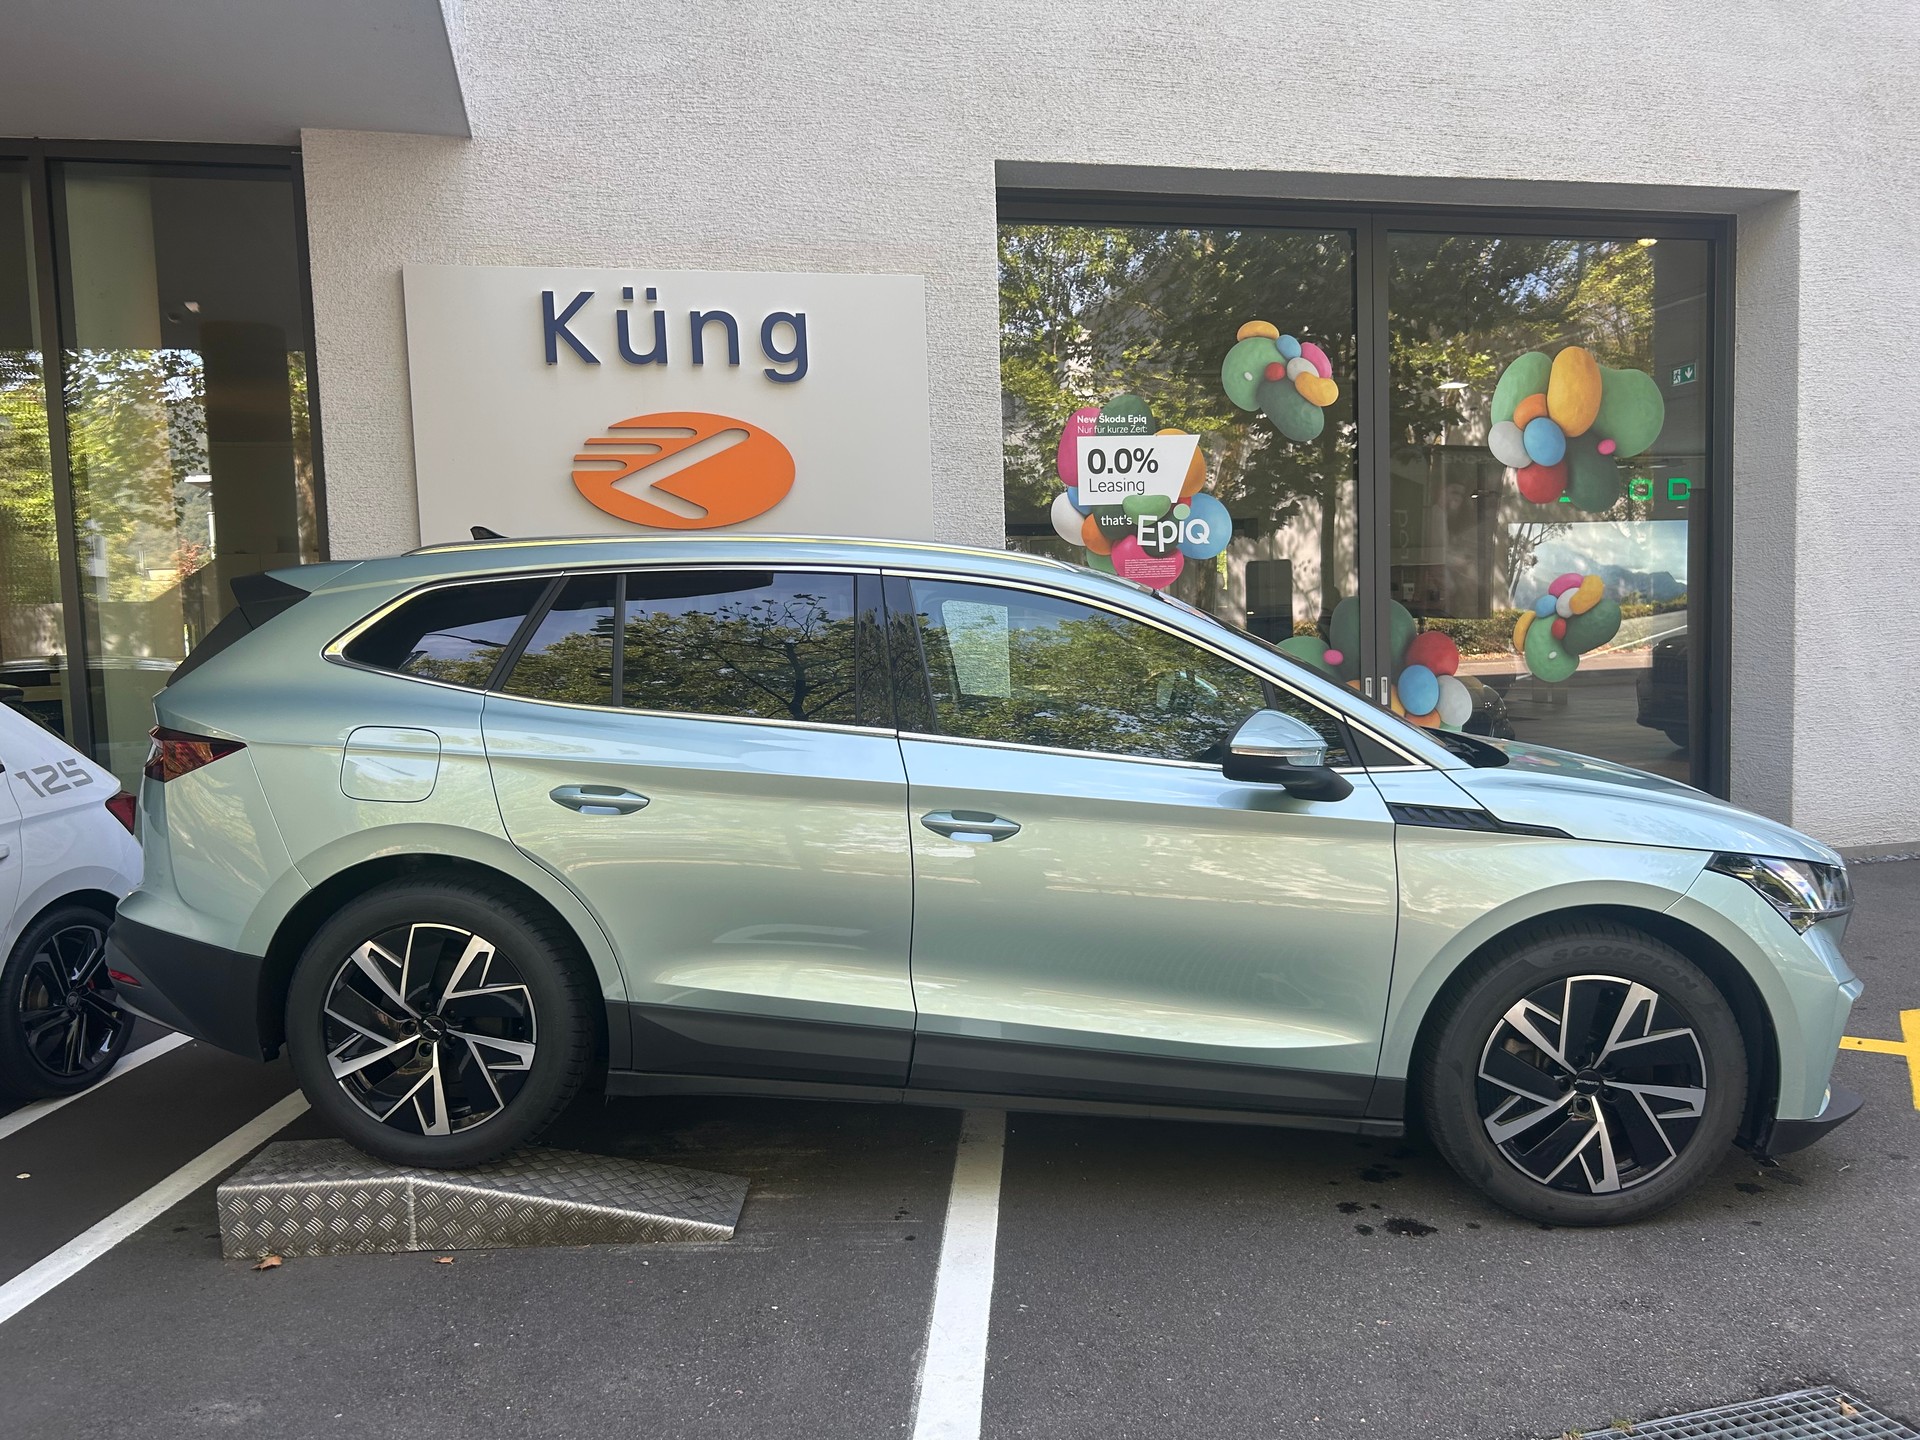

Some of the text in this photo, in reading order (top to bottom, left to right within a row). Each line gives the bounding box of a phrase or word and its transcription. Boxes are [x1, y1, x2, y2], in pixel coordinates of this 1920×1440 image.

[541, 286, 809, 384] Küng
[1077, 412, 1147, 425] New Škoda Epiq
[1077, 425, 1148, 434] Nur für kurze Zeit:
[1087, 447, 1159, 475] 0.0%
[1089, 478, 1145, 495] Leasing
[1101, 514, 1133, 526] that's
[15, 758, 94, 799] 125
[1552, 945, 1699, 991] SCORPION
